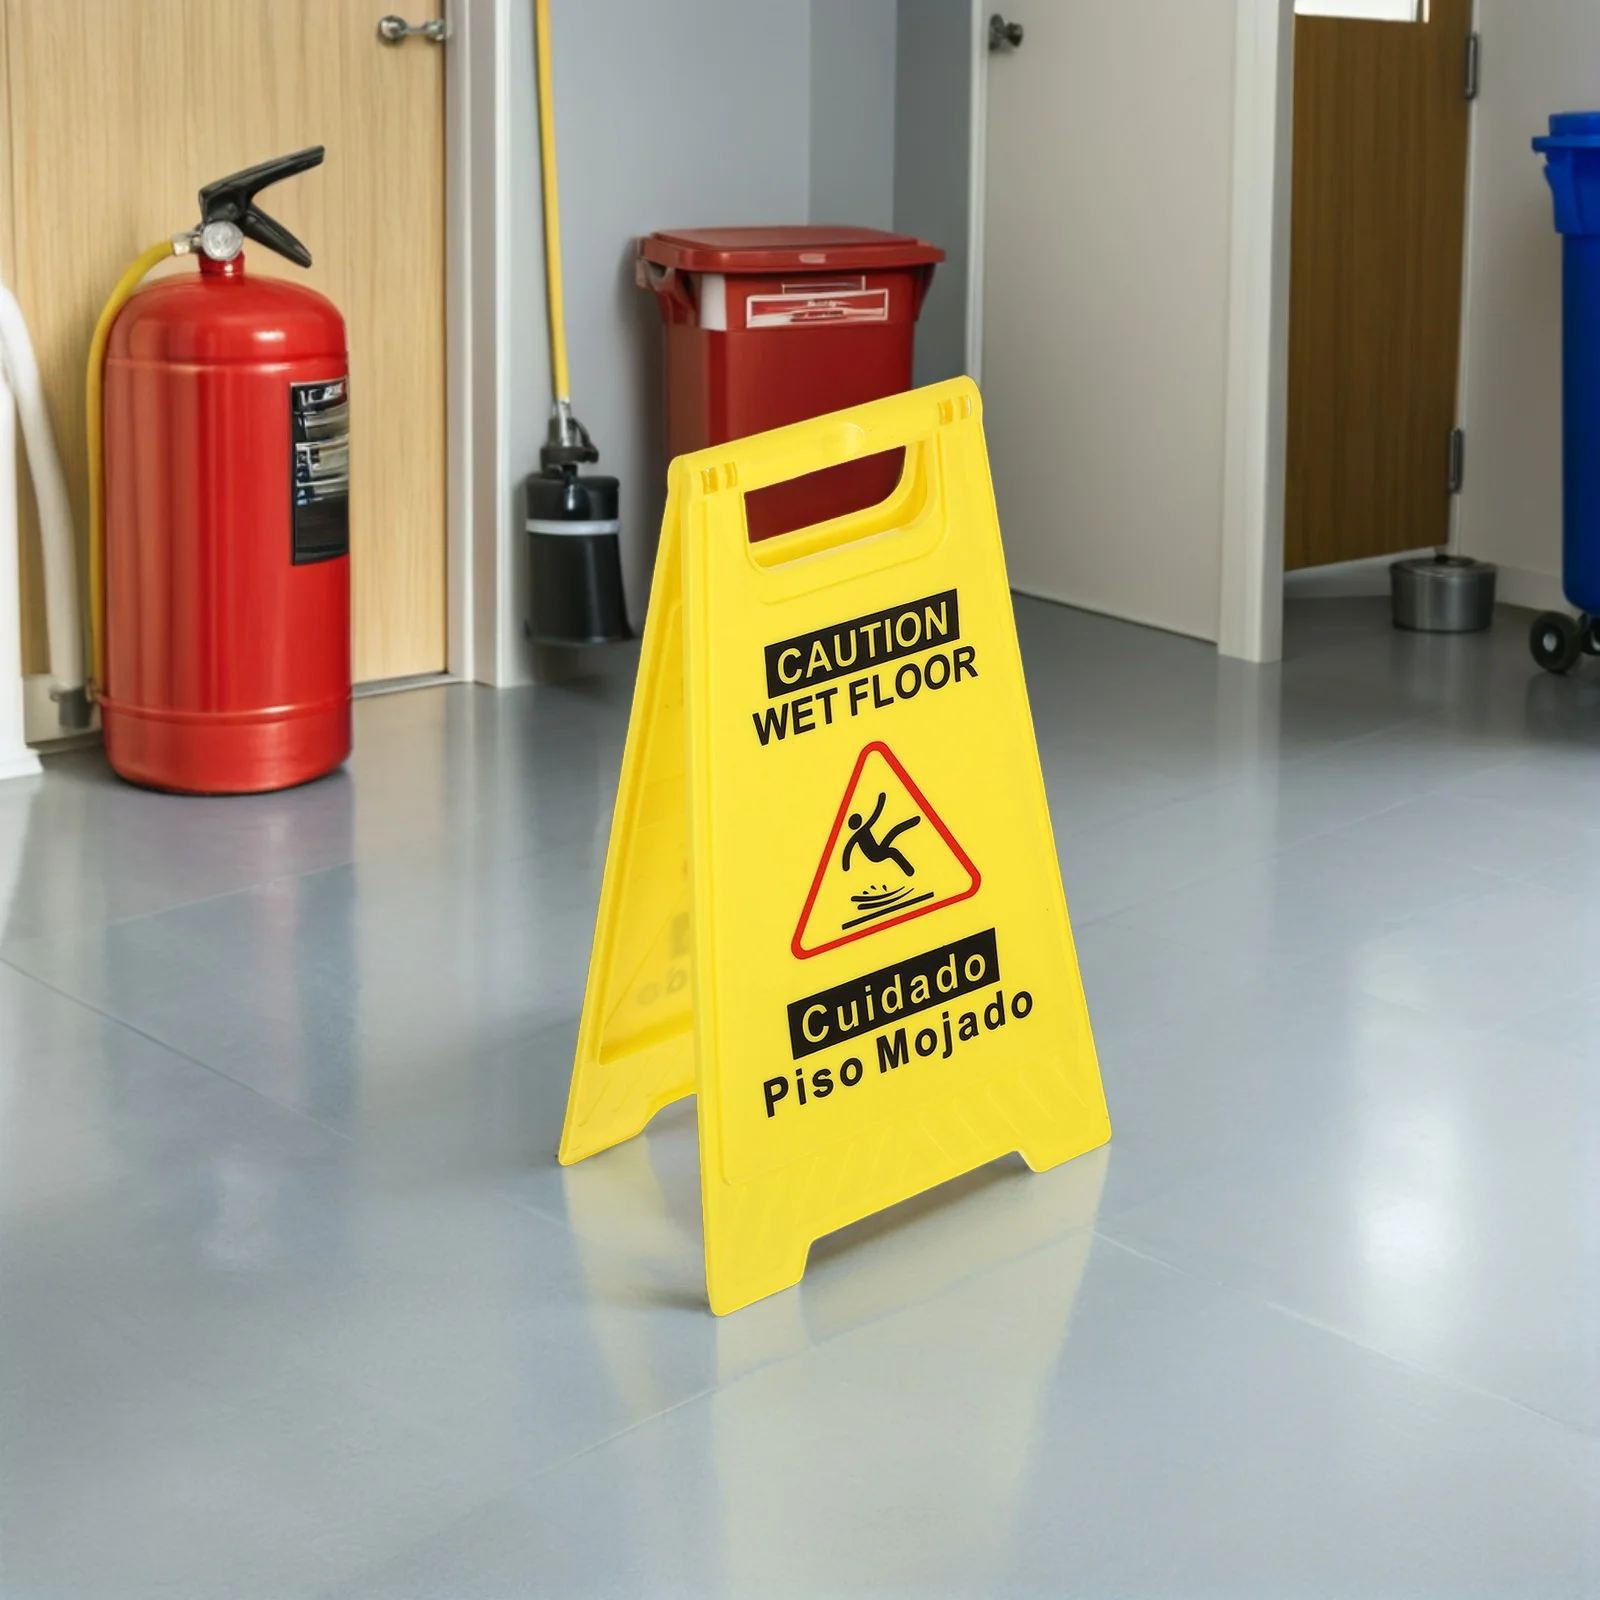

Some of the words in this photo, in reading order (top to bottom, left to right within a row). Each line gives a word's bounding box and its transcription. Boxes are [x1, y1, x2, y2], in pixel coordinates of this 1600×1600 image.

[777, 600, 948, 685] CAUTION
[752, 687, 838, 746] WET
[849, 645, 979, 717] FLOOR
[802, 952, 986, 1043] Cuidado
[763, 1057, 864, 1118] Piso
[876, 986, 1033, 1074] Mojado
